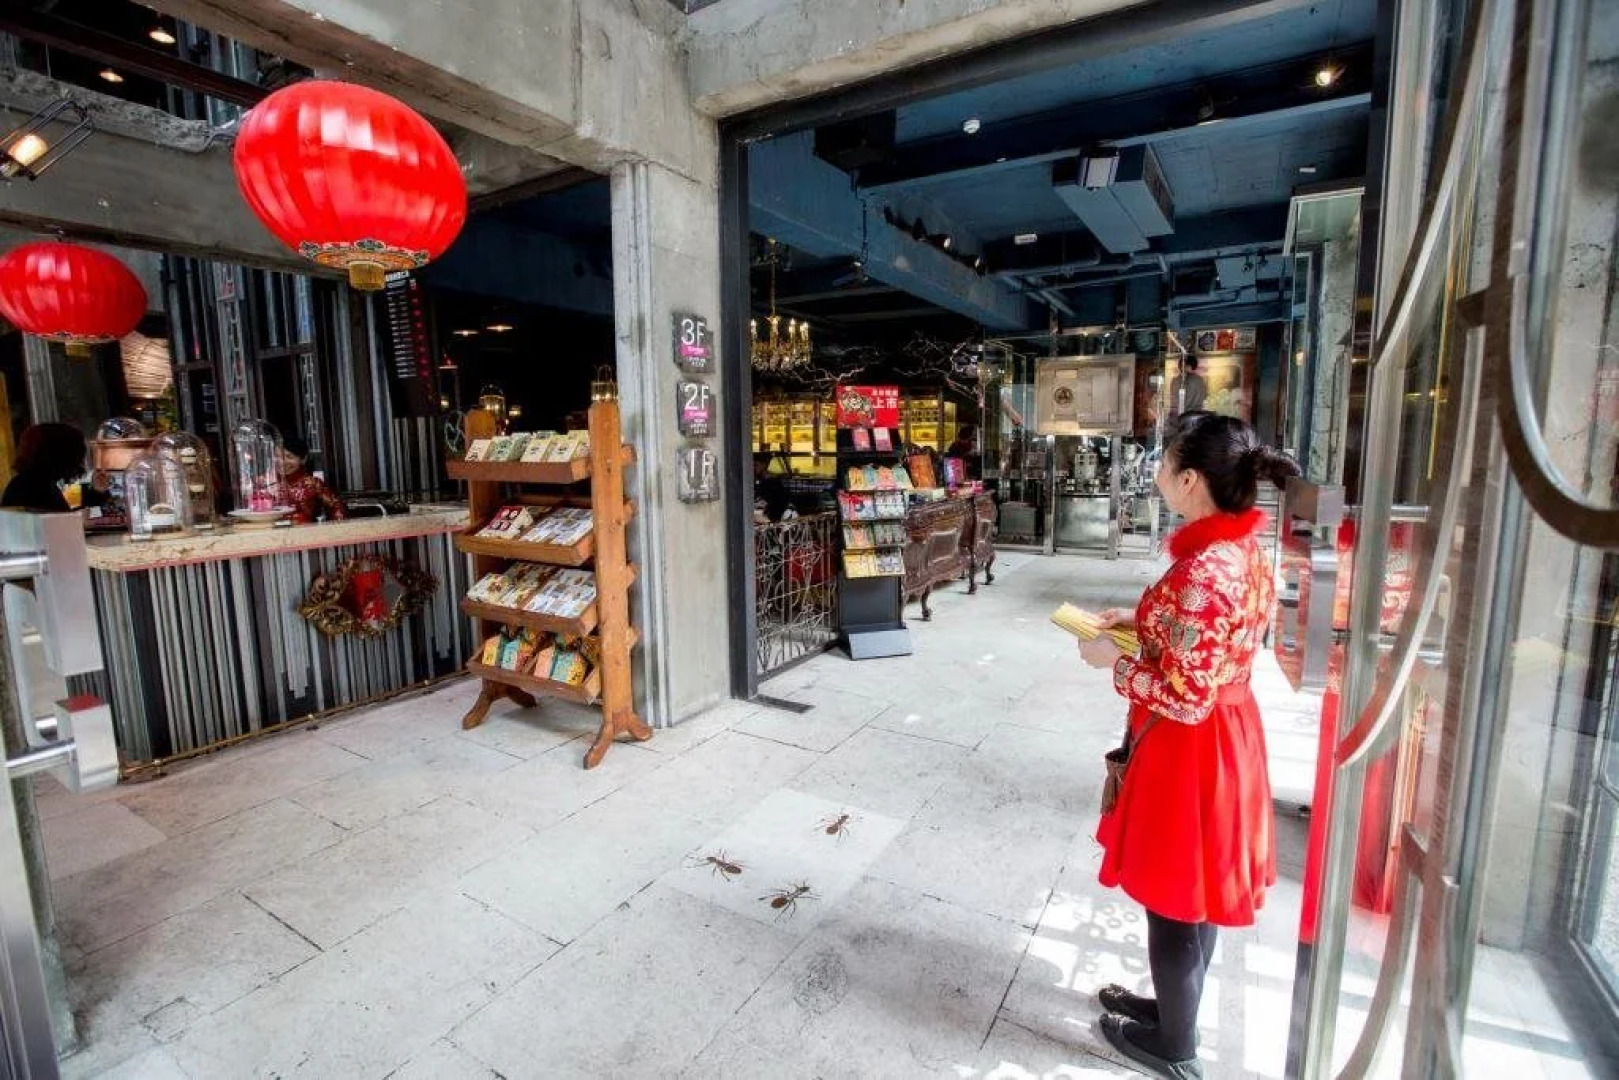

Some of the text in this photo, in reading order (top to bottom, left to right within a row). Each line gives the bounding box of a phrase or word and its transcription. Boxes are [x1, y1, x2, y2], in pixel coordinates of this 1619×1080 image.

[681, 318, 705, 346] 3F
[684, 383, 709, 410] 2F
[690, 449, 710, 478] 1F
